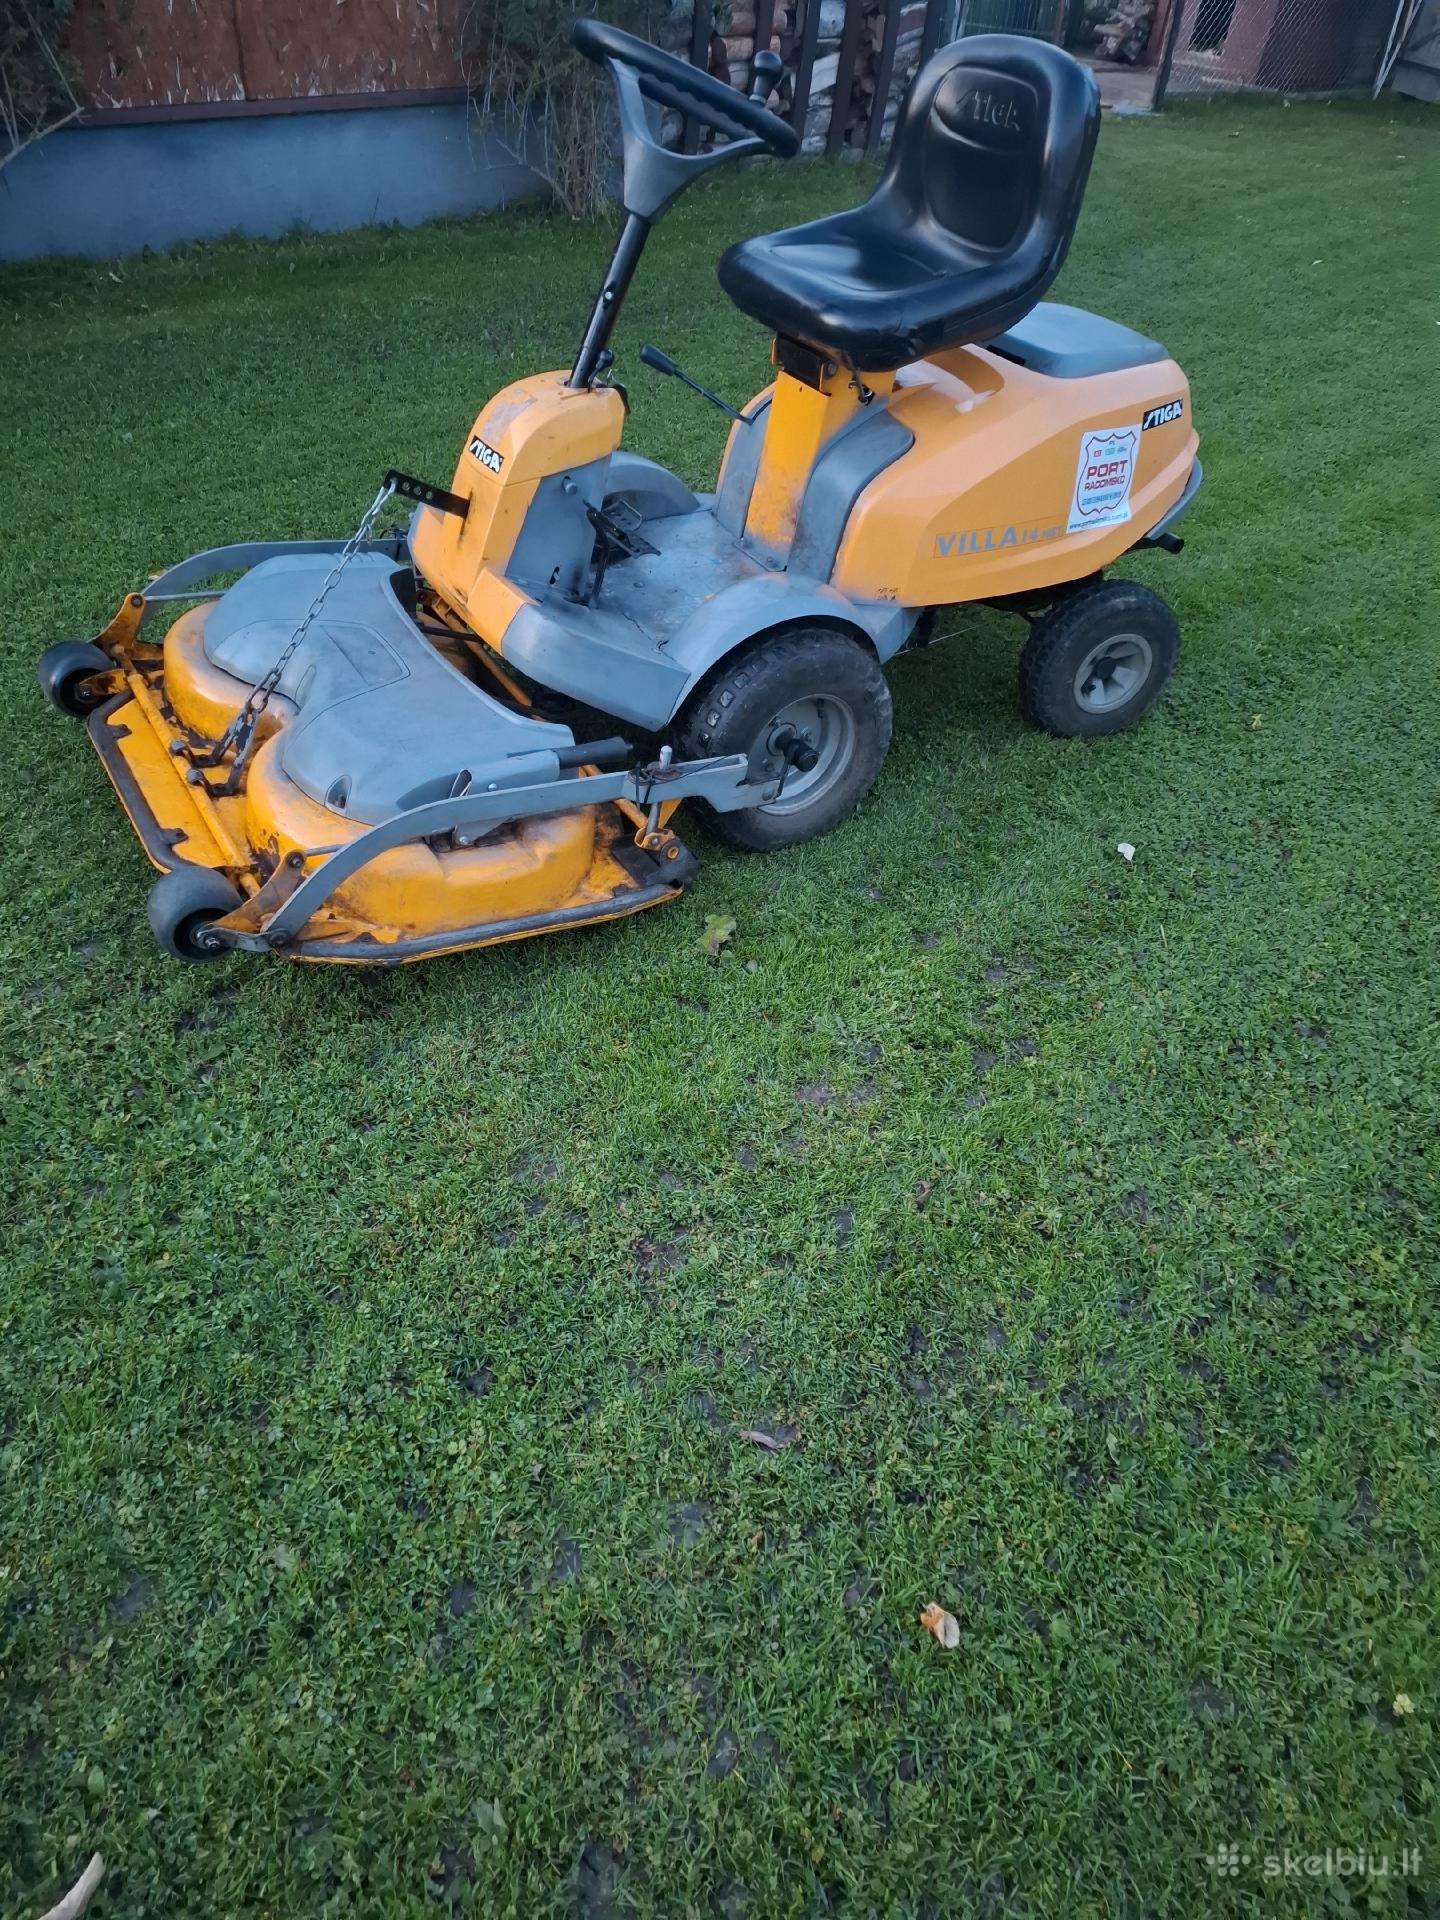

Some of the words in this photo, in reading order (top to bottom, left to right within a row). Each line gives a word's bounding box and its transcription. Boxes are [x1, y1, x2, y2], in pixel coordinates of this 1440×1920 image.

[1142, 400, 1182, 430] STIGA
[468, 438, 502, 473] STIGA
[1086, 459, 1128, 480] PORT
[938, 525, 1017, 556] VILLA
